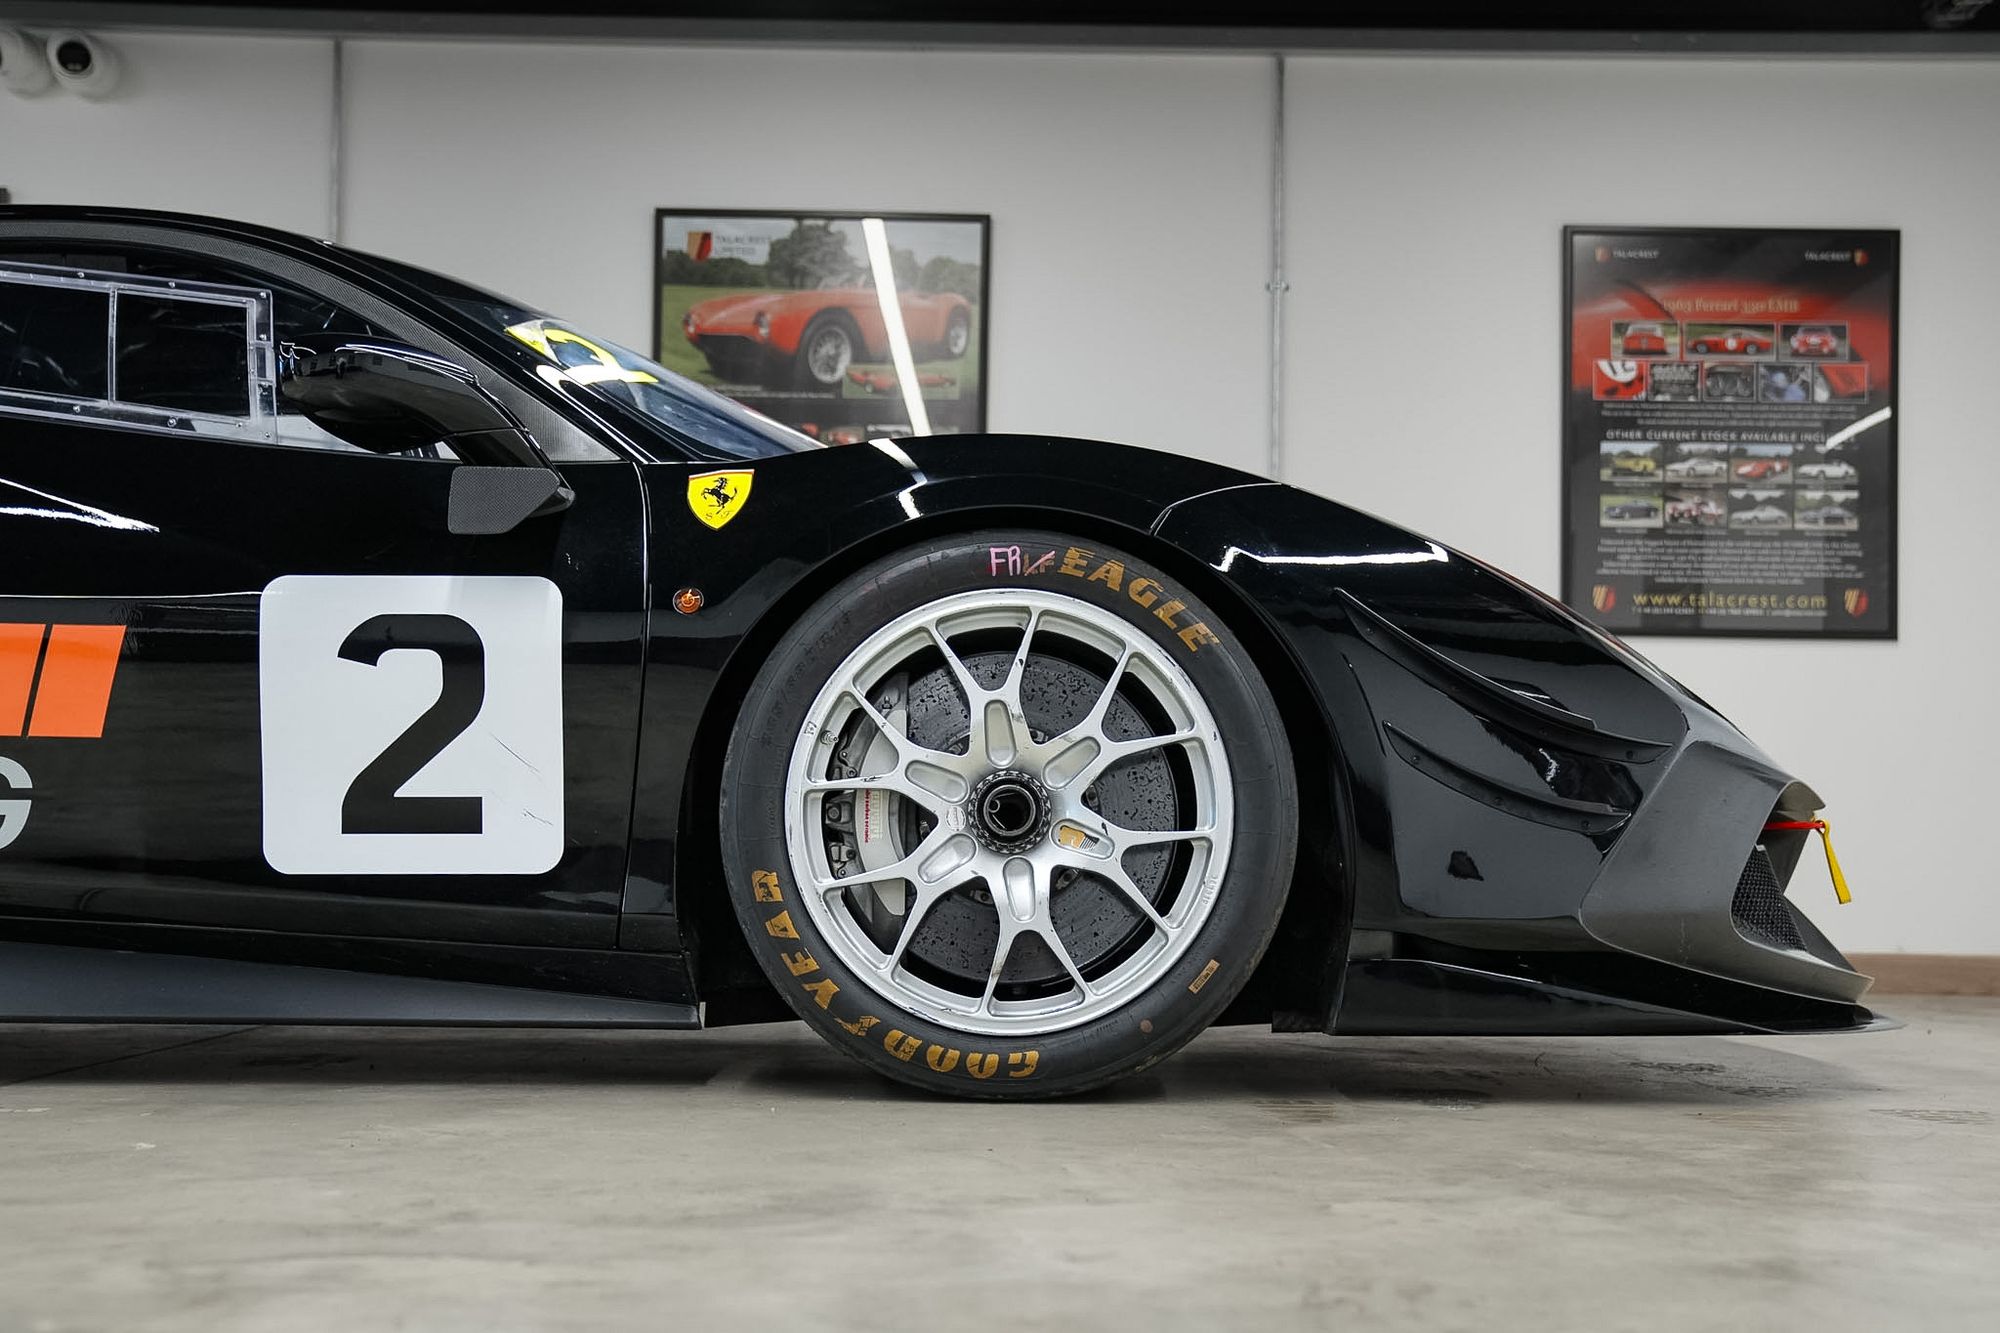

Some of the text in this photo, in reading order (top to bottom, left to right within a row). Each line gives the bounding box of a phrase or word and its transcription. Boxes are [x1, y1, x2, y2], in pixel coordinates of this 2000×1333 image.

[1605, 429, 1643, 440] OTHER
[1646, 429, 1698, 441] CURRENT
[1700, 430, 1738, 441] STOCK
[1740, 430, 1798, 442] AVAILABLE
[1057, 546, 1221, 653] EAGLE
[1632, 591, 1828, 609] www.talacrest.com
[337, 613, 486, 835] 2
[751, 870, 1040, 1080] GOODYEAR
